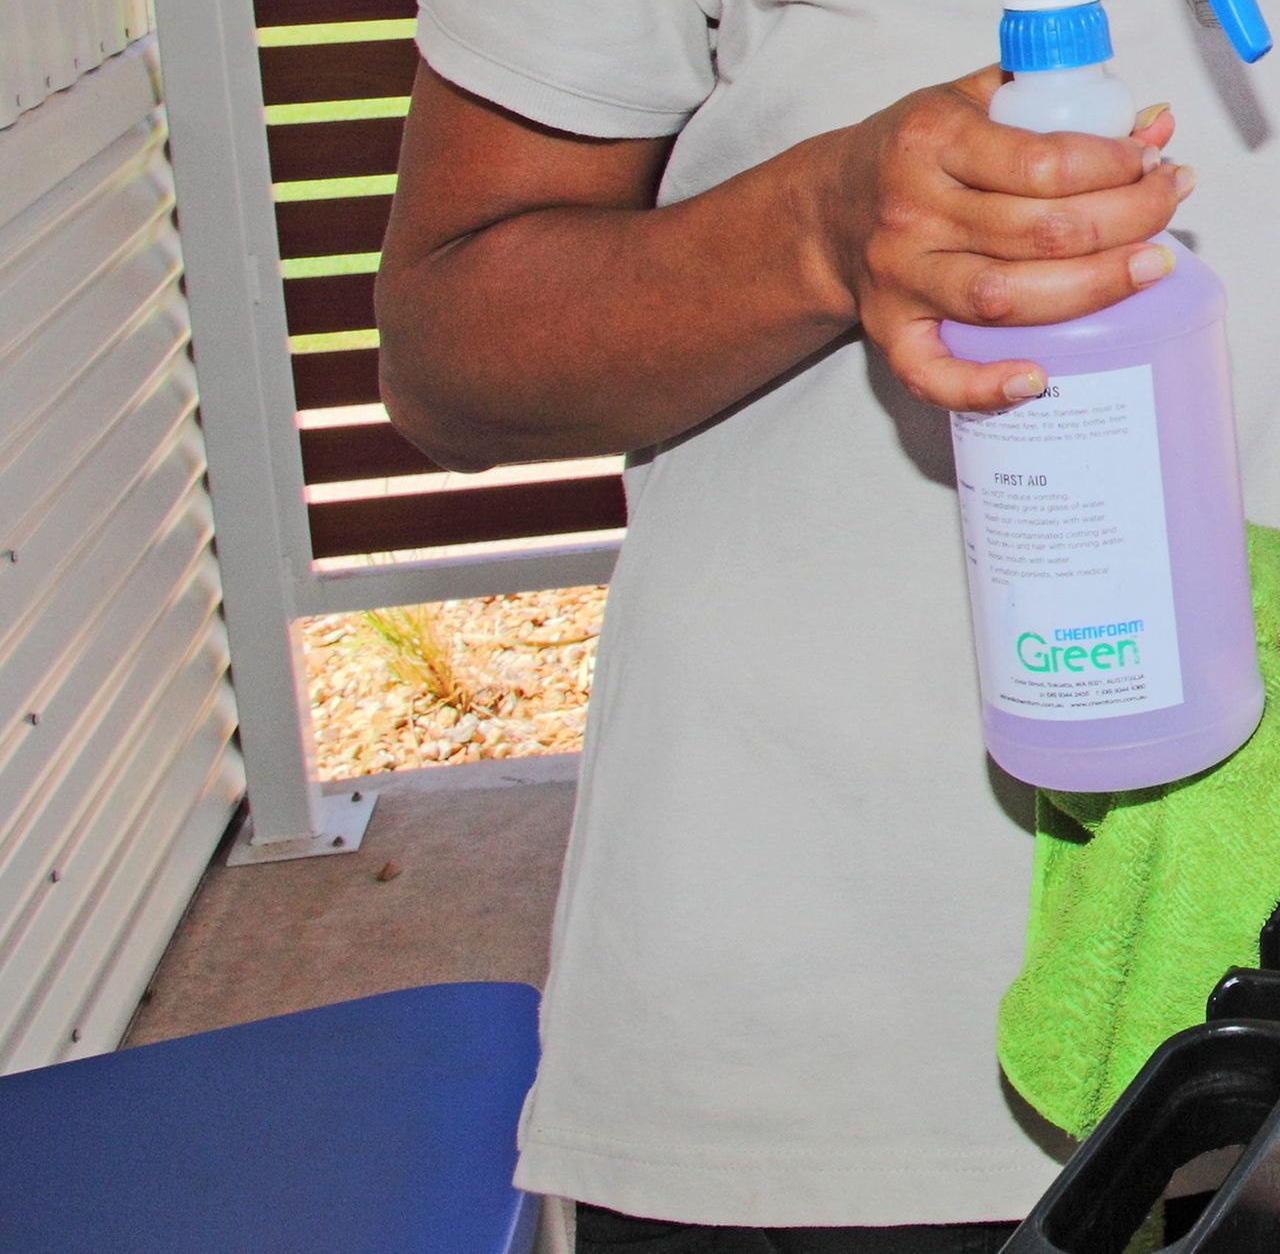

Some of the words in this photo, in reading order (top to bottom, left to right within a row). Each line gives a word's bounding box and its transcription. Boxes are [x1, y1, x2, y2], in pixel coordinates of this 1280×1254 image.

[994, 473, 1023, 486] FIRST
[1027, 474, 1047, 486] AID
[1054, 619, 1143, 642] CHEMFORM
[1016, 631, 1138, 673] Green
